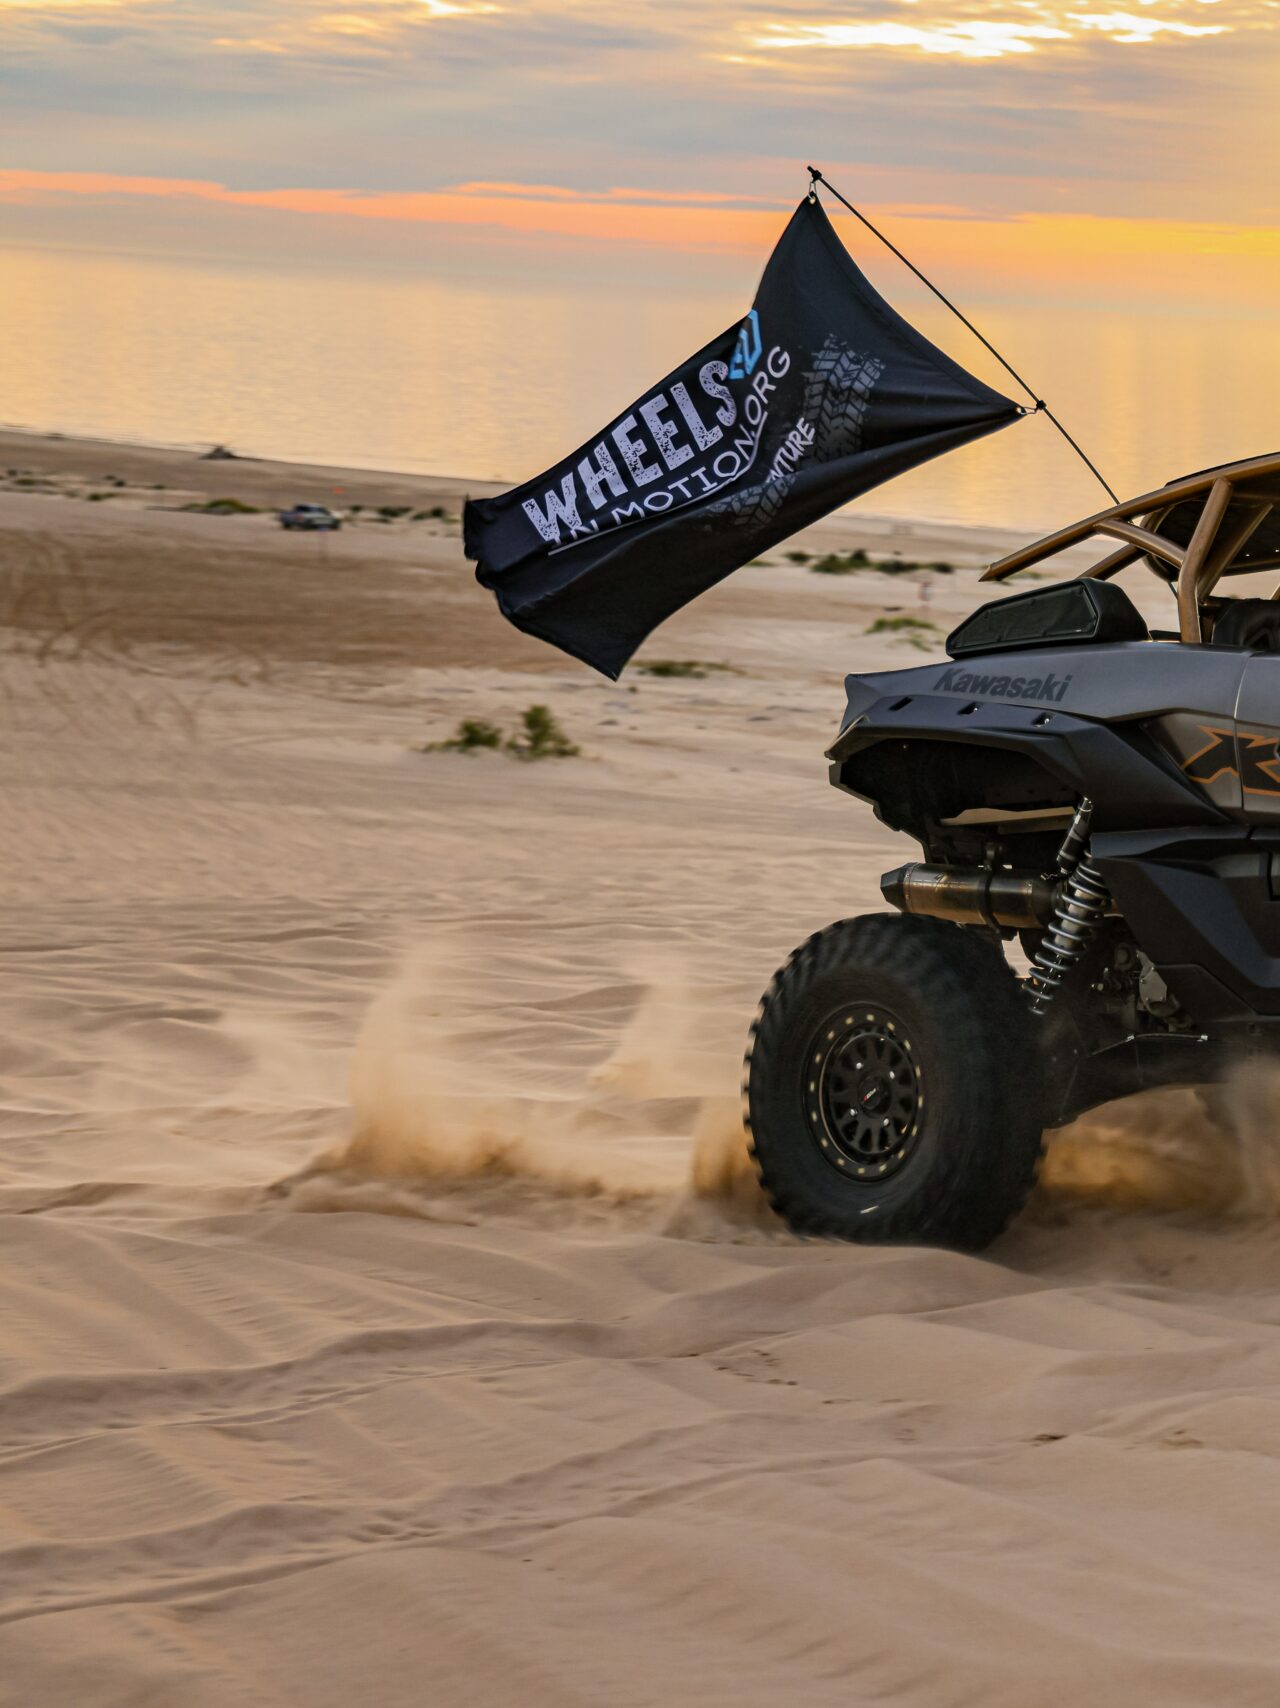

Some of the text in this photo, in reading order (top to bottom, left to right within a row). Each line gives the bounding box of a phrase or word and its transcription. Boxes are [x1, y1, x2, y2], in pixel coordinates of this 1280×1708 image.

[521, 360, 737, 541] WHEELS
[611, 346, 791, 525] MOTION.ORG
[765, 417, 816, 484] NTURE
[933, 668, 1073, 702] Kawasaki
